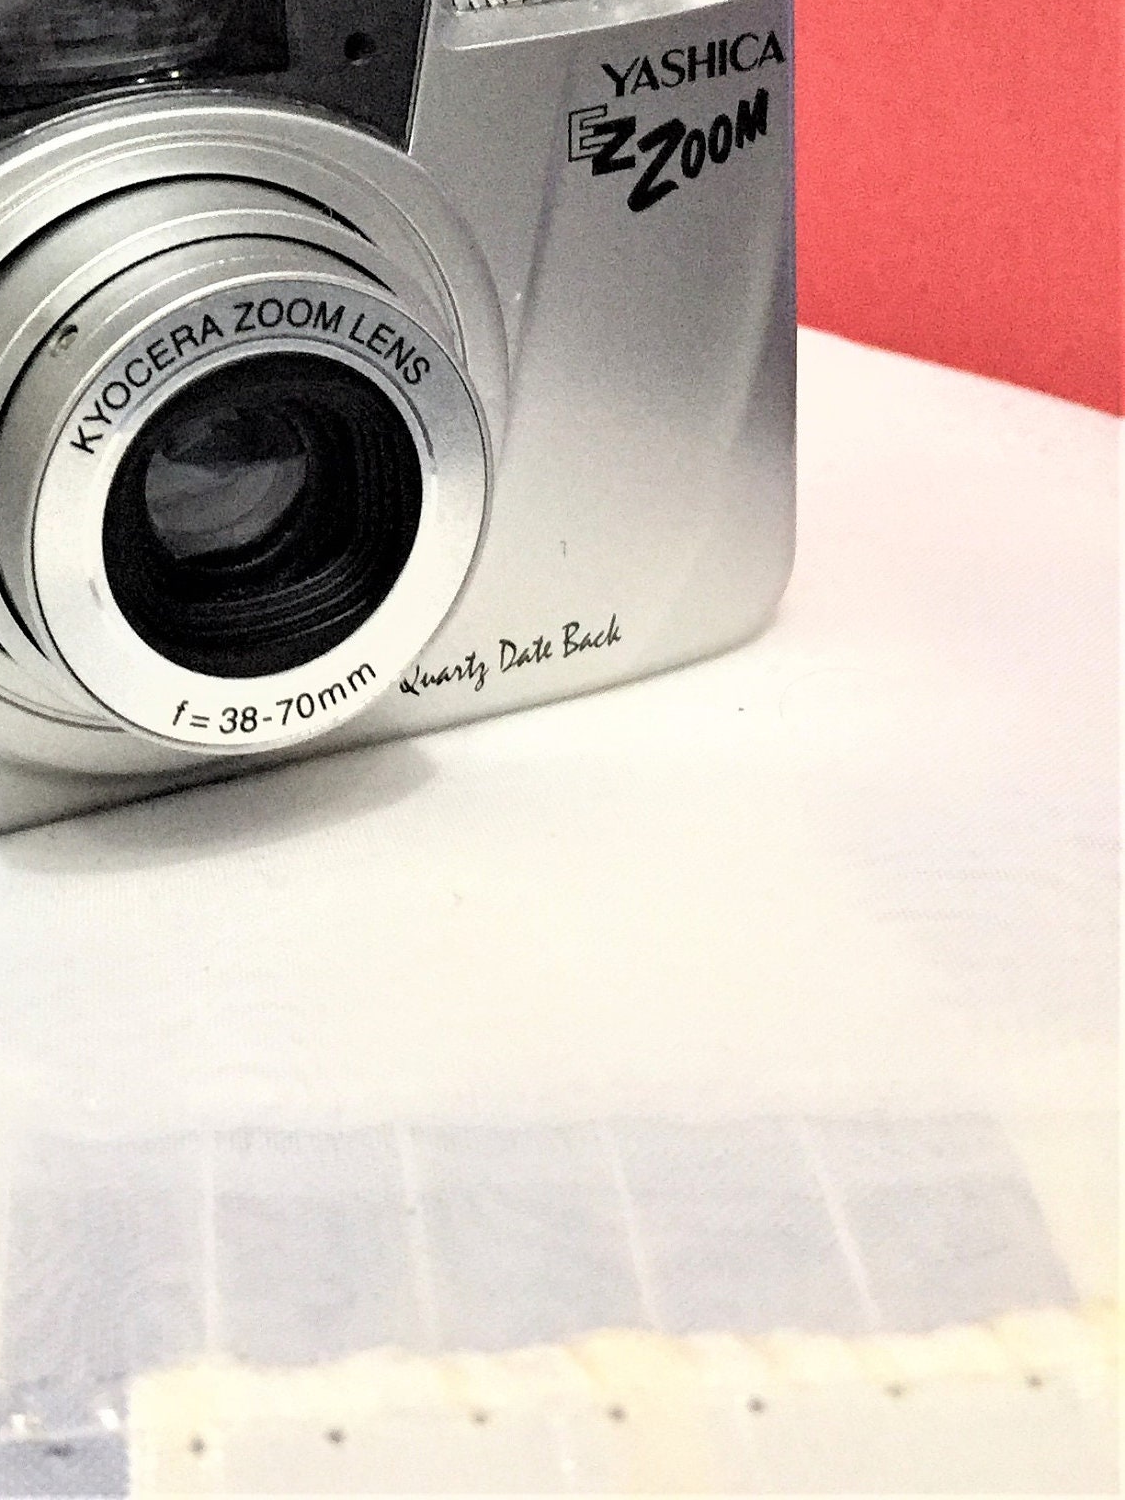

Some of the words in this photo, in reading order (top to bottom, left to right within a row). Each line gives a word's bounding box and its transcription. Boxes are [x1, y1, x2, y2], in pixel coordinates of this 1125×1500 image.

[601, 30, 786, 97] YASHICA
[627, 87, 769, 212] ZOOM
[70, 314, 223, 455] KYOCERA
[233, 298, 345, 333] ZOOM
[350, 312, 431, 386] LENS
[399, 652, 489, 696] Quartz
[499, 635, 553, 674] Date
[562, 613, 622, 659] Back
